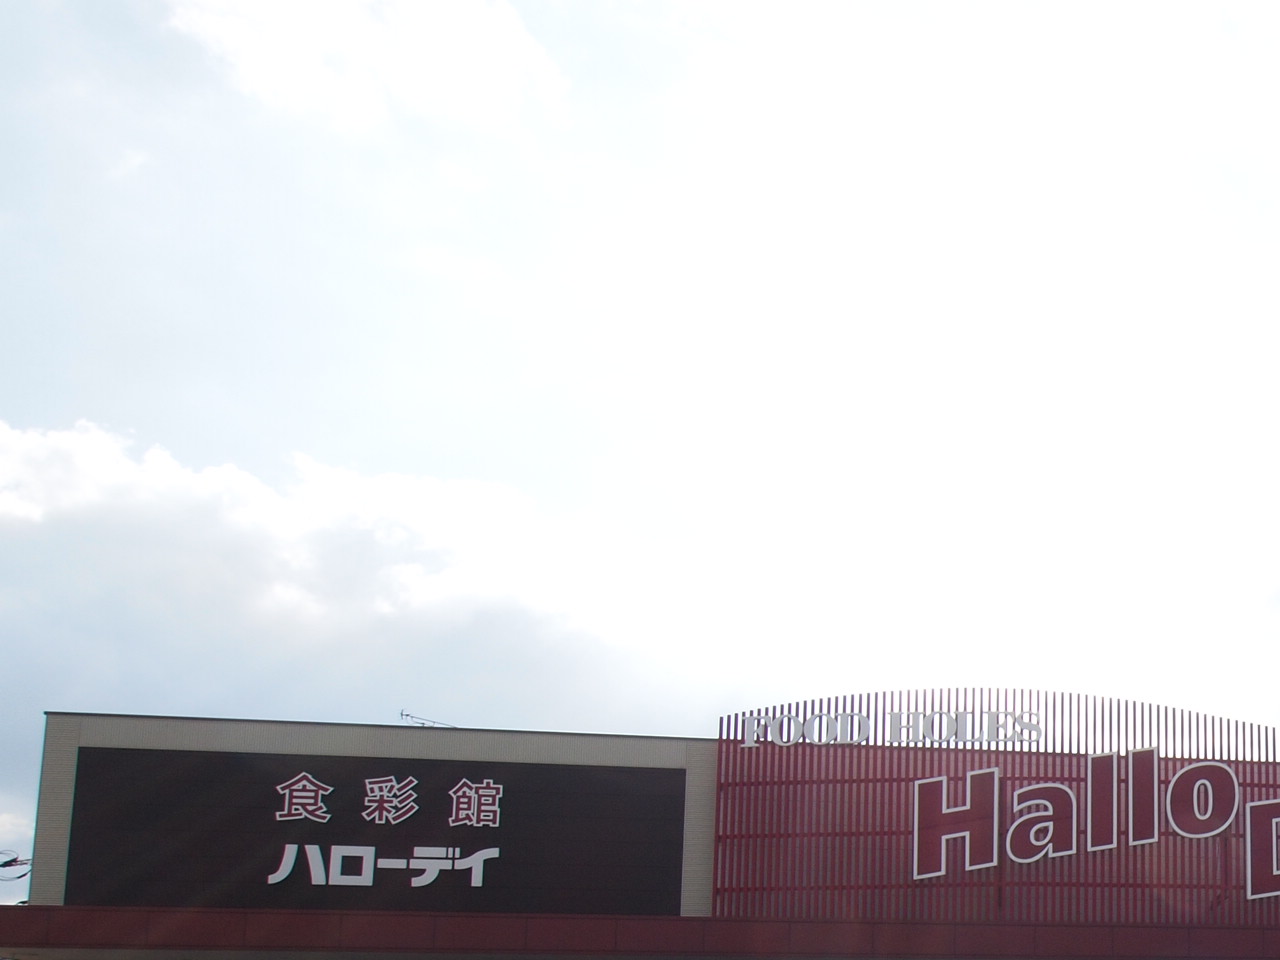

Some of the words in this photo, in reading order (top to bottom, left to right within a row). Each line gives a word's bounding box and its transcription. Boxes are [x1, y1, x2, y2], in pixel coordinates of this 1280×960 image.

[740, 712, 870, 748] FOOD
[887, 711, 1042, 744] HOLES
[275, 771, 503, 828] 食彩館
[913, 746, 1240, 880] Hallo
